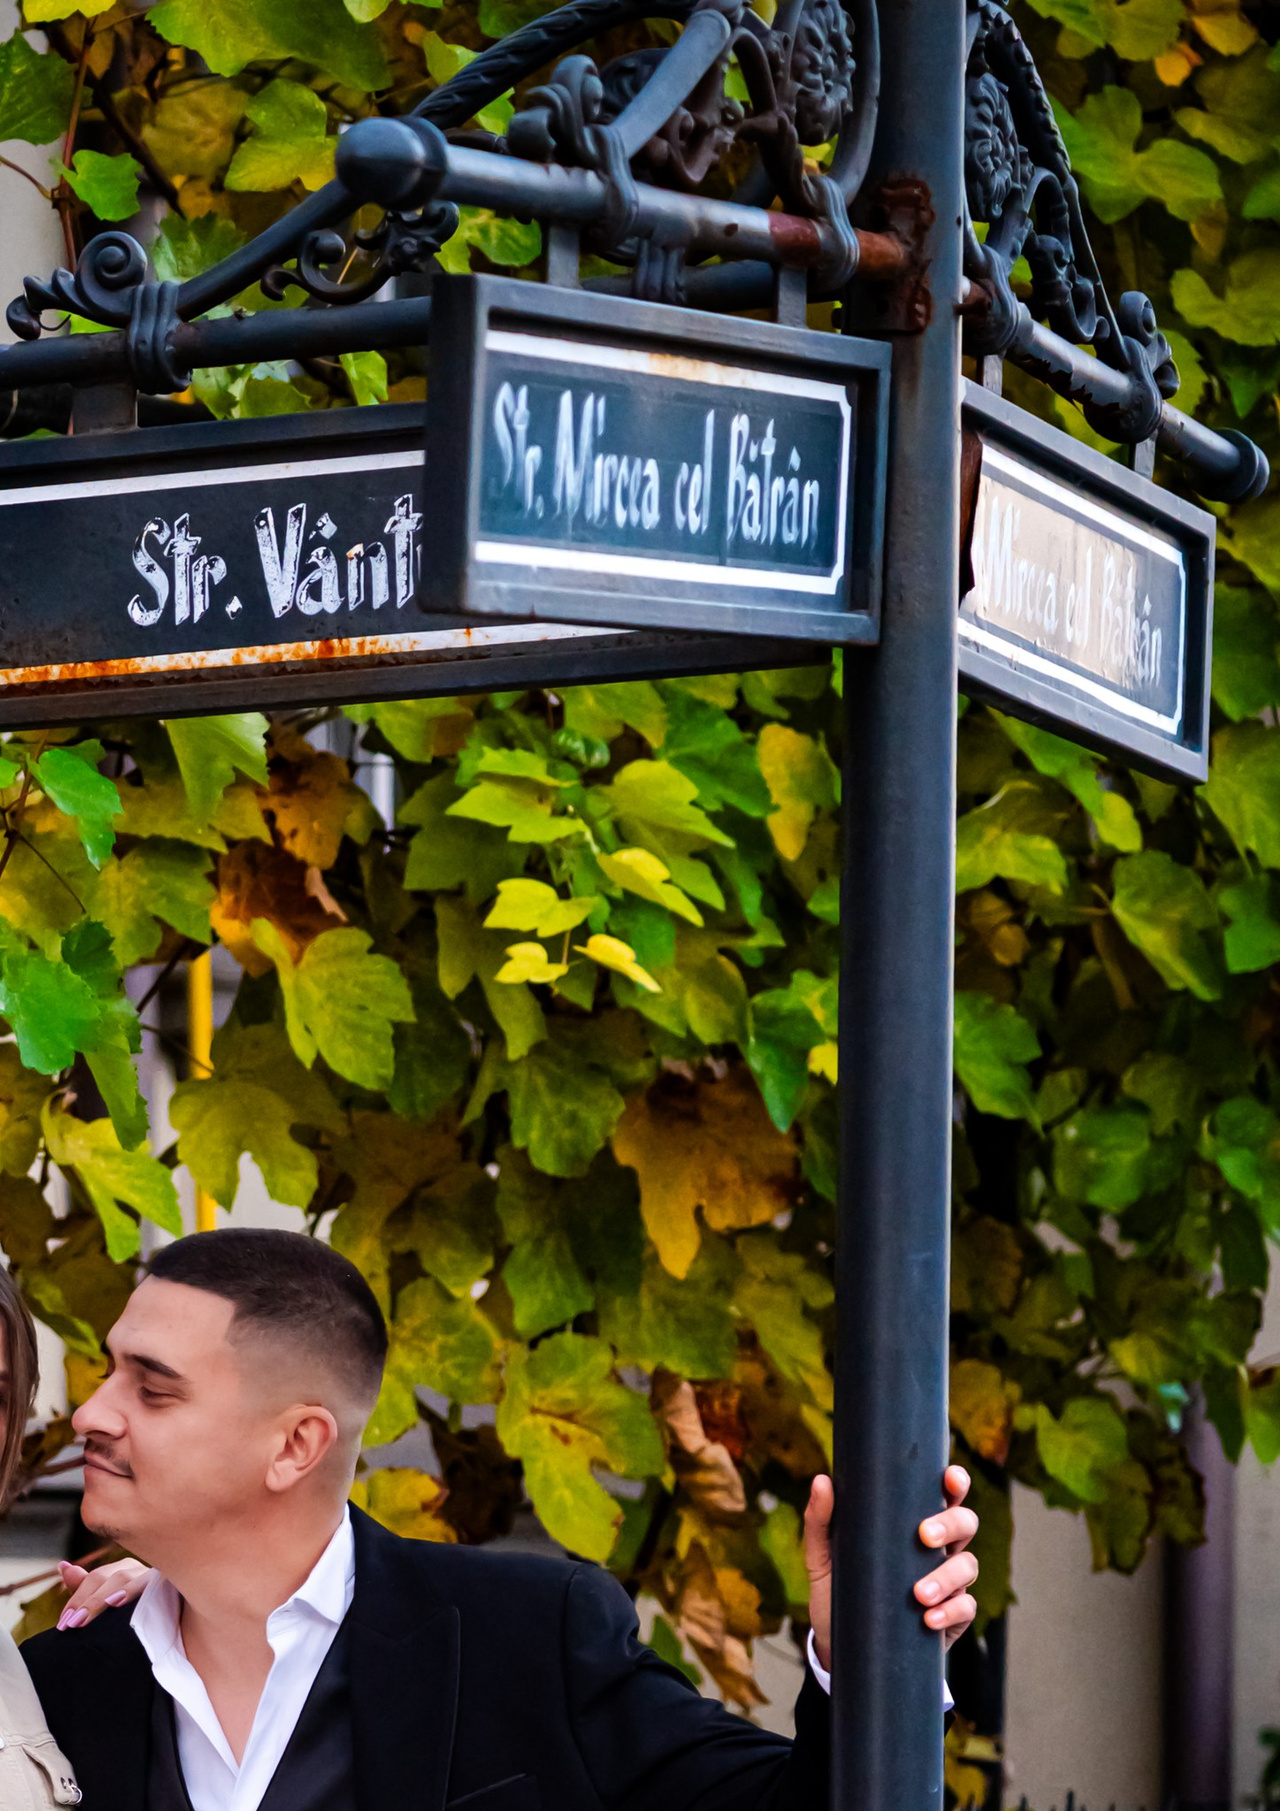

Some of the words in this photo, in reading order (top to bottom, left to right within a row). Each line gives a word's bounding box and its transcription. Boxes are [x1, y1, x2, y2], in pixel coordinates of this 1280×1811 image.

[492, 380, 545, 519] Str.
[553, 389, 661, 530] Mircea
[674, 408, 715, 535] cel
[127, 512, 243, 626] Str.
[254, 493, 423, 619] Vânt
